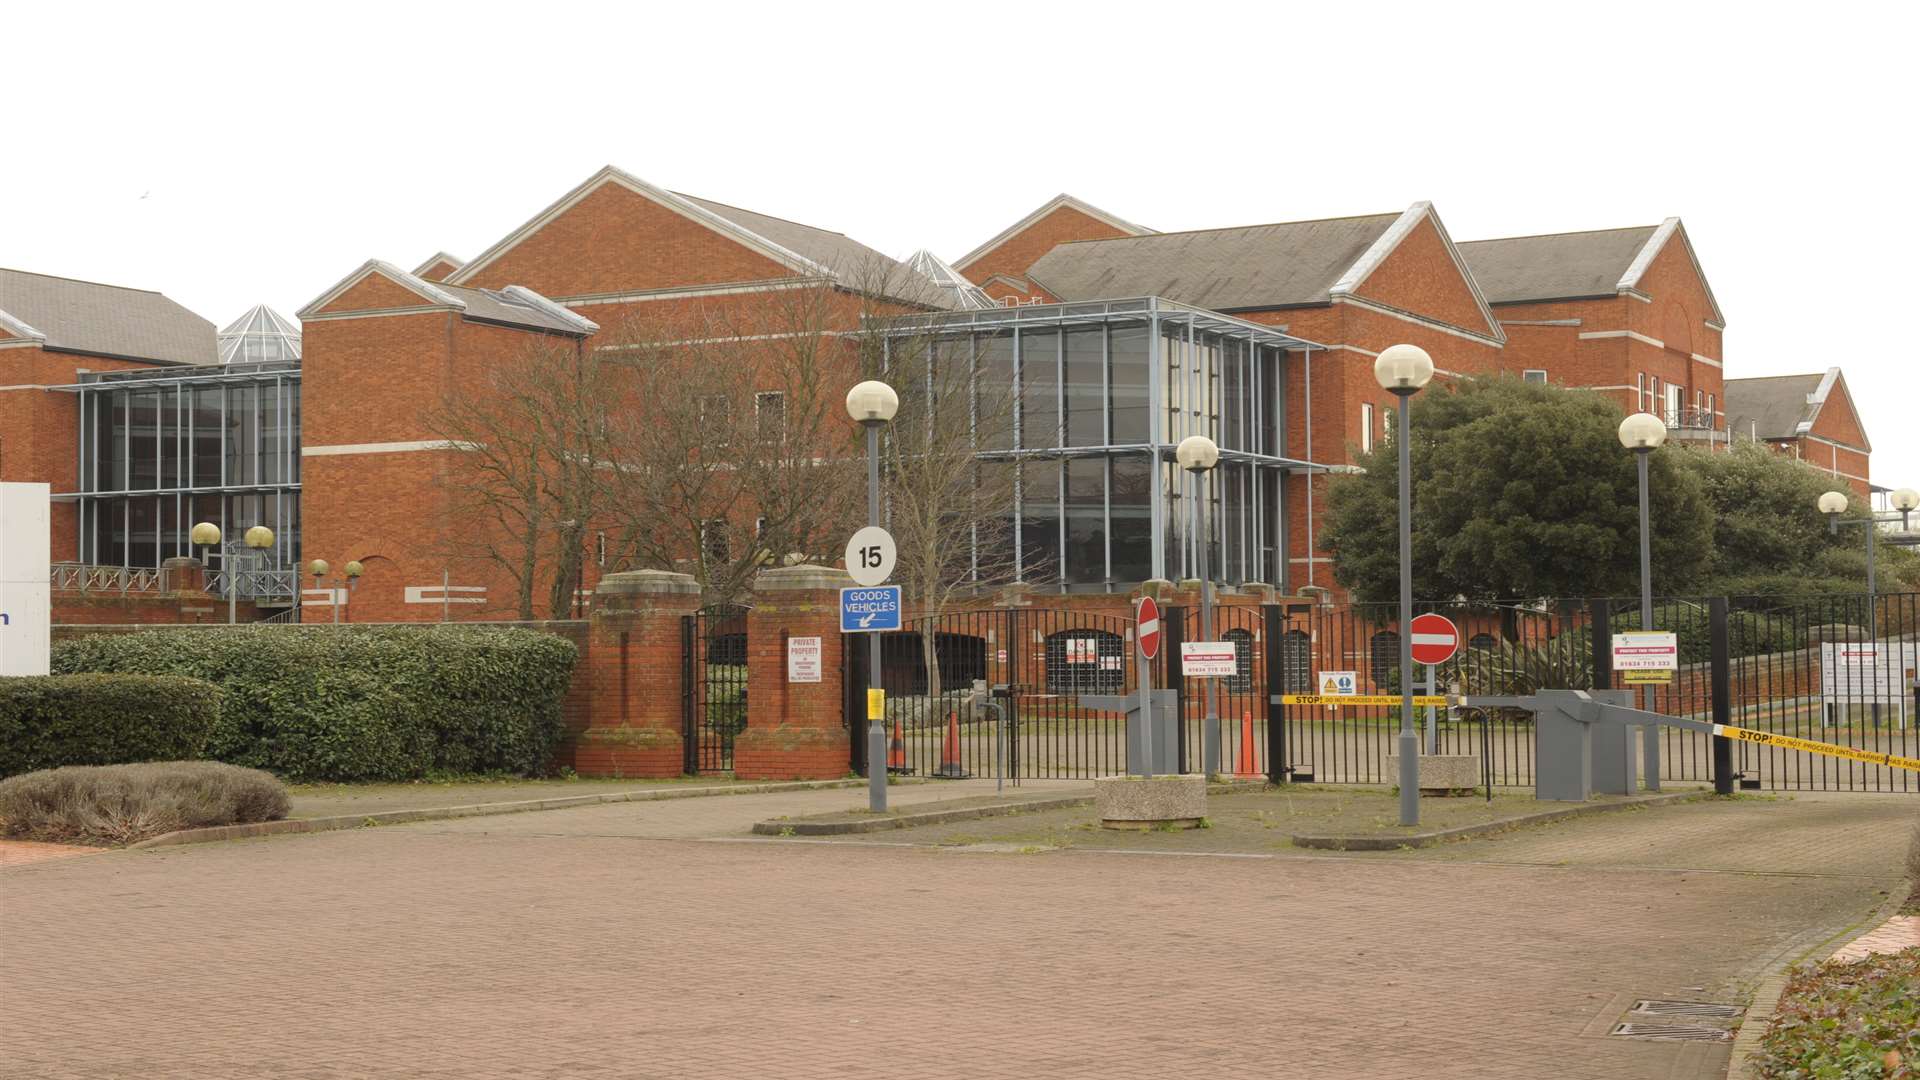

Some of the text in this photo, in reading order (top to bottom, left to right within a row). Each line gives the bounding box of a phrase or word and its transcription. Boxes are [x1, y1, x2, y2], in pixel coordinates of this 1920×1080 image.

[859, 546, 882, 568] 15
[850, 591, 891, 602] GOODS
[845, 602, 897, 612] VEHICLES
[1296, 696, 1322, 704] STOP!
[1739, 730, 1772, 744] STOP!
[1803, 742, 1834, 753] PROCEED
[1836, 748, 1855, 757] UNTIL
